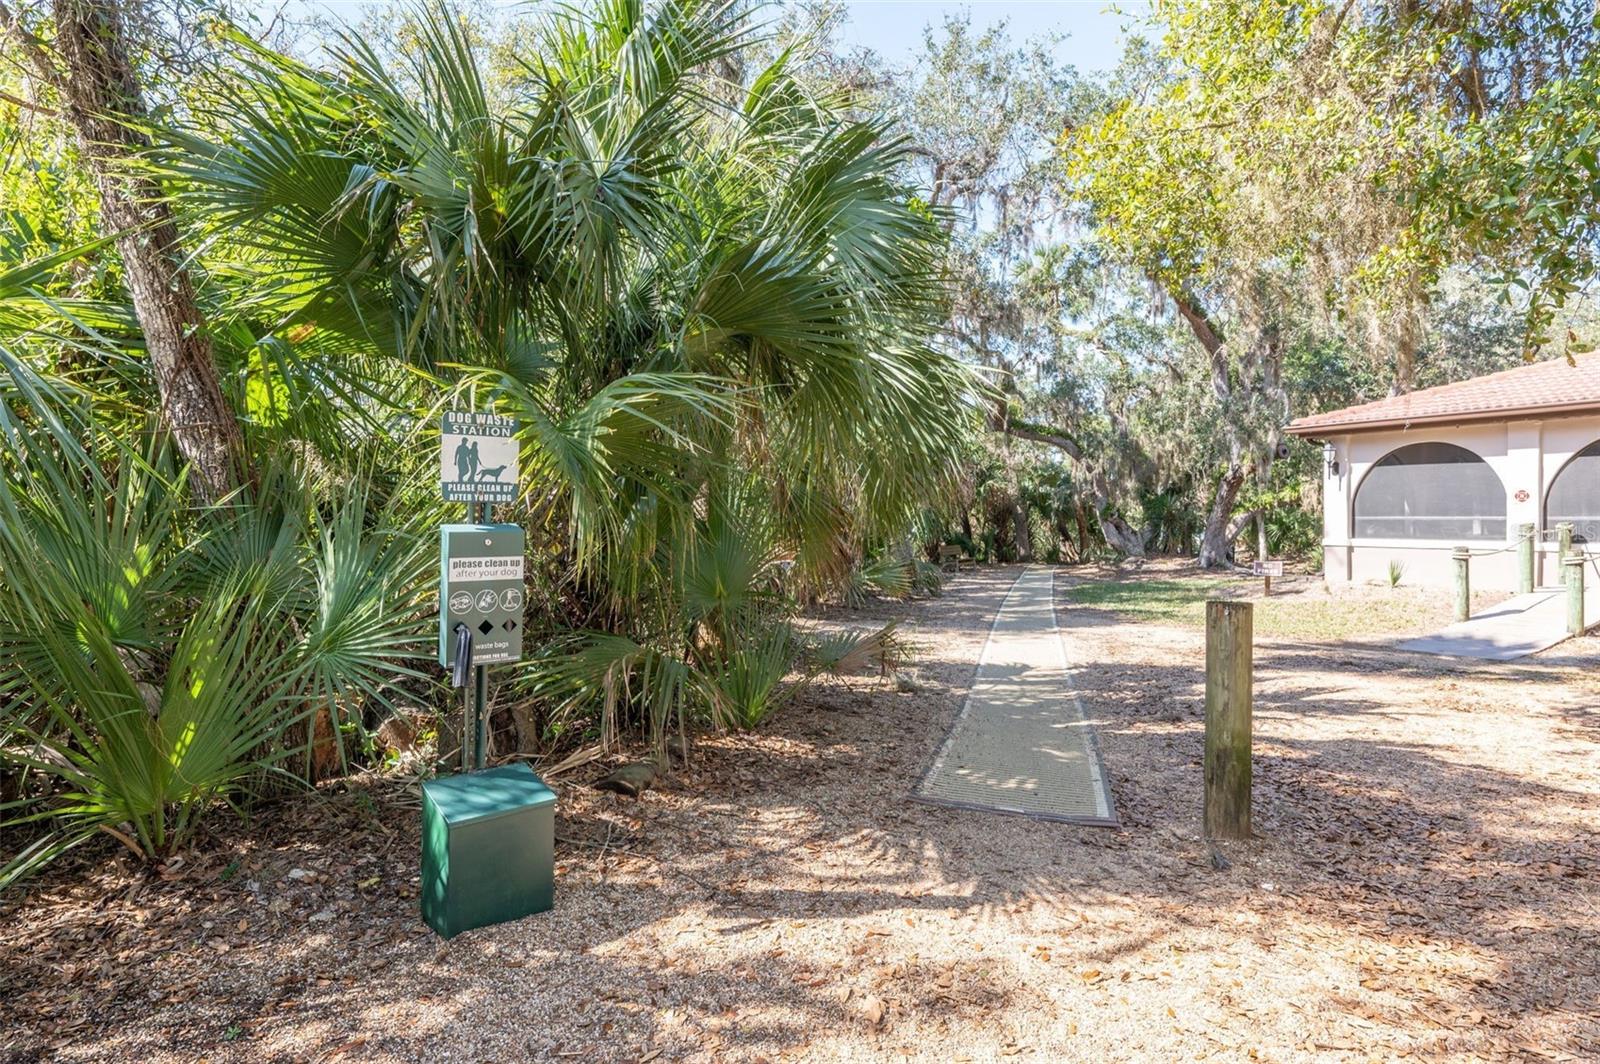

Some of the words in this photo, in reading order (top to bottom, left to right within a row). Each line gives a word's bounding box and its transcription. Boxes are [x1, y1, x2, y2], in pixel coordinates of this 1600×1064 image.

[448, 412, 472, 423] DOG
[475, 414, 515, 426] WASTE
[452, 425, 511, 437] STATION
[447, 483, 475, 492] PLEASE
[477, 484, 501, 492] CLEAN
[503, 485, 513, 493] UP
[449, 493, 472, 501] AFTER
[474, 494, 495, 502] YOUR
[496, 494, 512, 502] DOG
[453, 560, 482, 569] please
[484, 559, 508, 567] clean
[510, 559, 520, 567] up
[455, 569, 476, 578] after
[478, 569, 499, 578] your
[500, 568, 518, 577] dog
[475, 642, 493, 650] waste
[494, 641, 509, 649] bags
